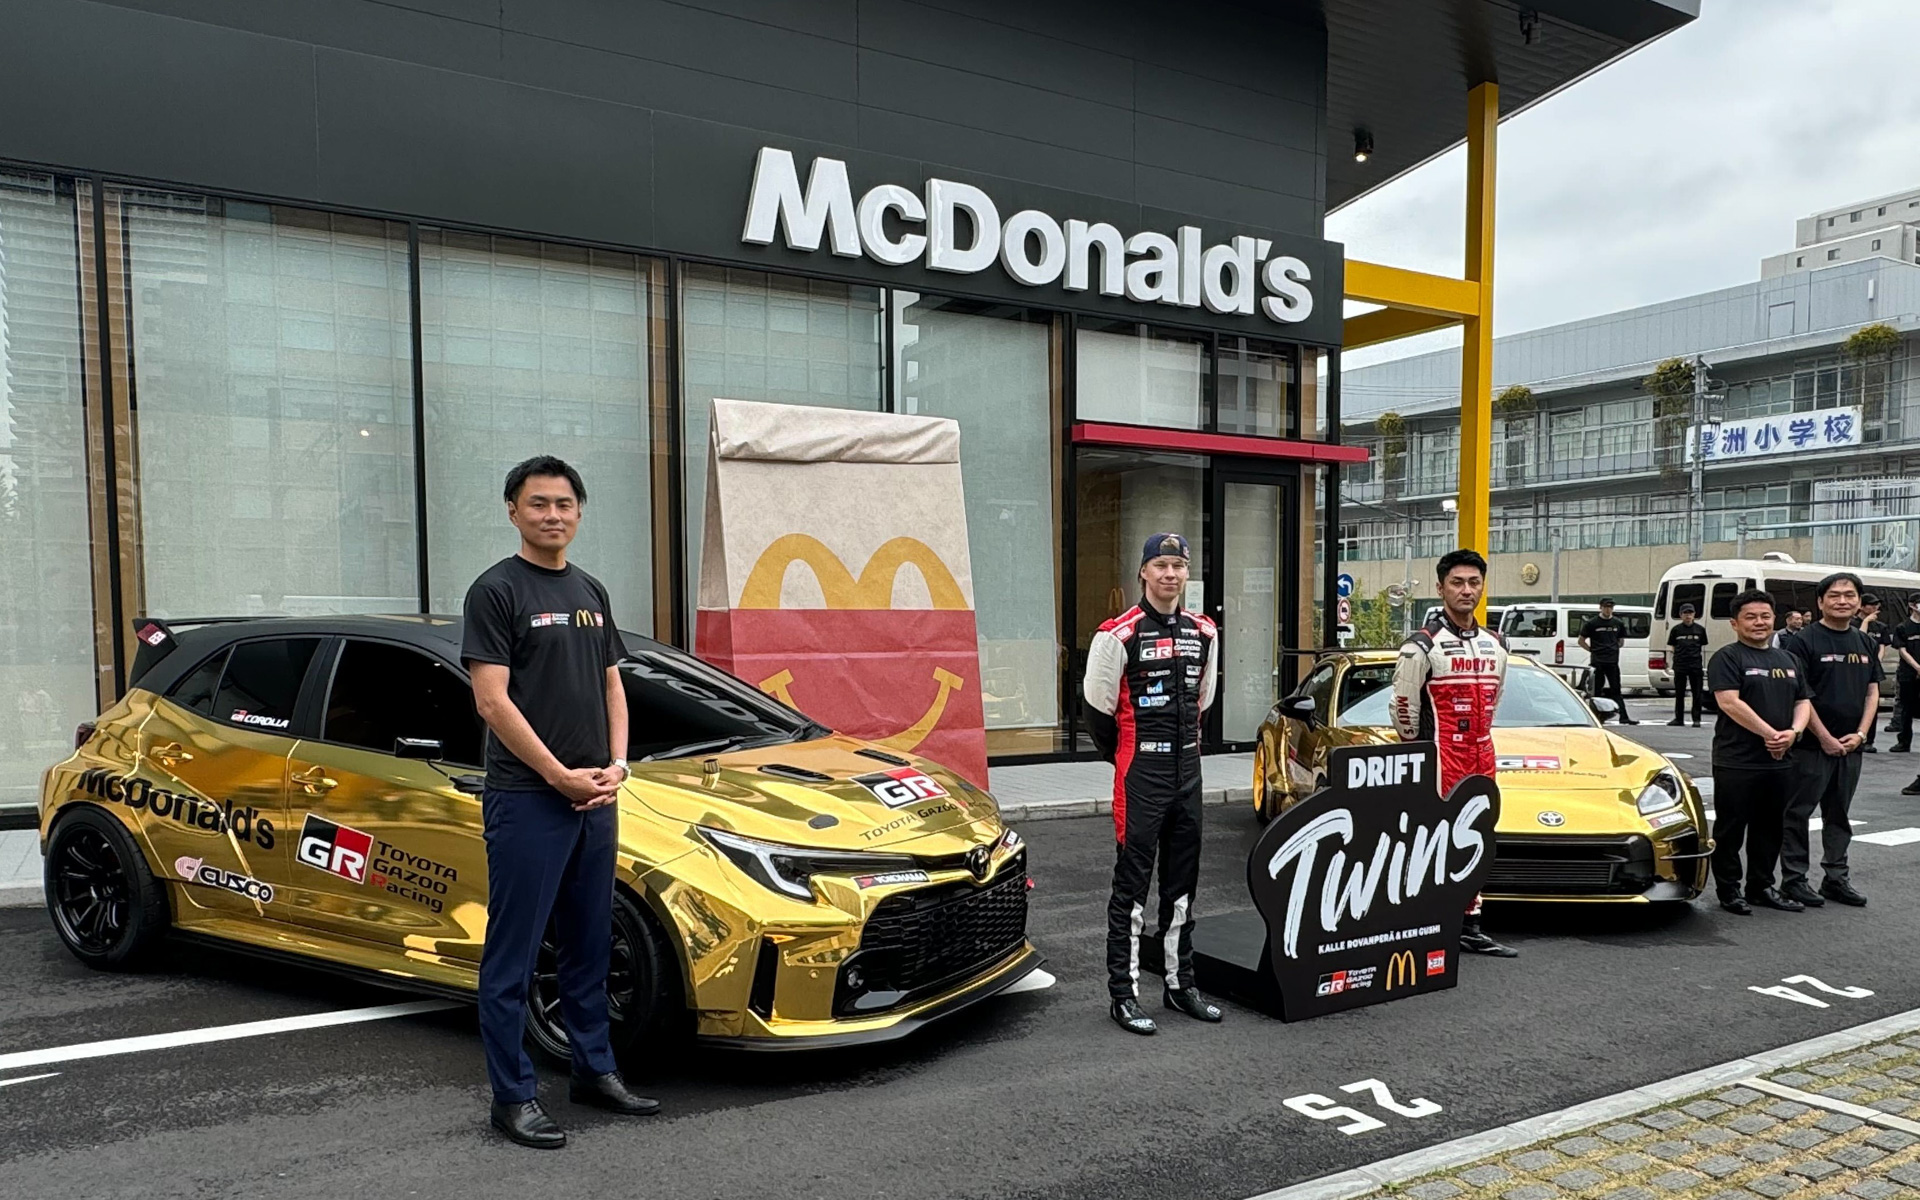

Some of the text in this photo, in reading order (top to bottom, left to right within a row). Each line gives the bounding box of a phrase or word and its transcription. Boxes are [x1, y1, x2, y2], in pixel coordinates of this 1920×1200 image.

[742, 146, 1314, 324] McDonald's
[1141, 645, 1171, 659] GR
[244, 714, 290, 729] COROLLA
[1348, 753, 1425, 789] DRIFT
[77, 766, 275, 850] McDonald's
[874, 775, 945, 806] GR
[859, 813, 917, 841] TOYOTA
[917, 803, 957, 819] GAZOO
[300, 836, 365, 881] GR
[373, 858, 448, 895] GAZOO
[377, 841, 458, 882] TOYOTA
[1268, 794, 1491, 959] Twins
[370, 873, 444, 914] Racing
[874, 871, 927, 884] YOKOHAMA
[1318, 941, 1346, 955] KALLE
[1346, 931, 1396, 949] ROVANPERÄ
[1396, 931, 1402, 941] &
[1402, 928, 1418, 940] KEN
[1318, 979, 1344, 995] GR
[1283, 1078, 1443, 1136] 25
